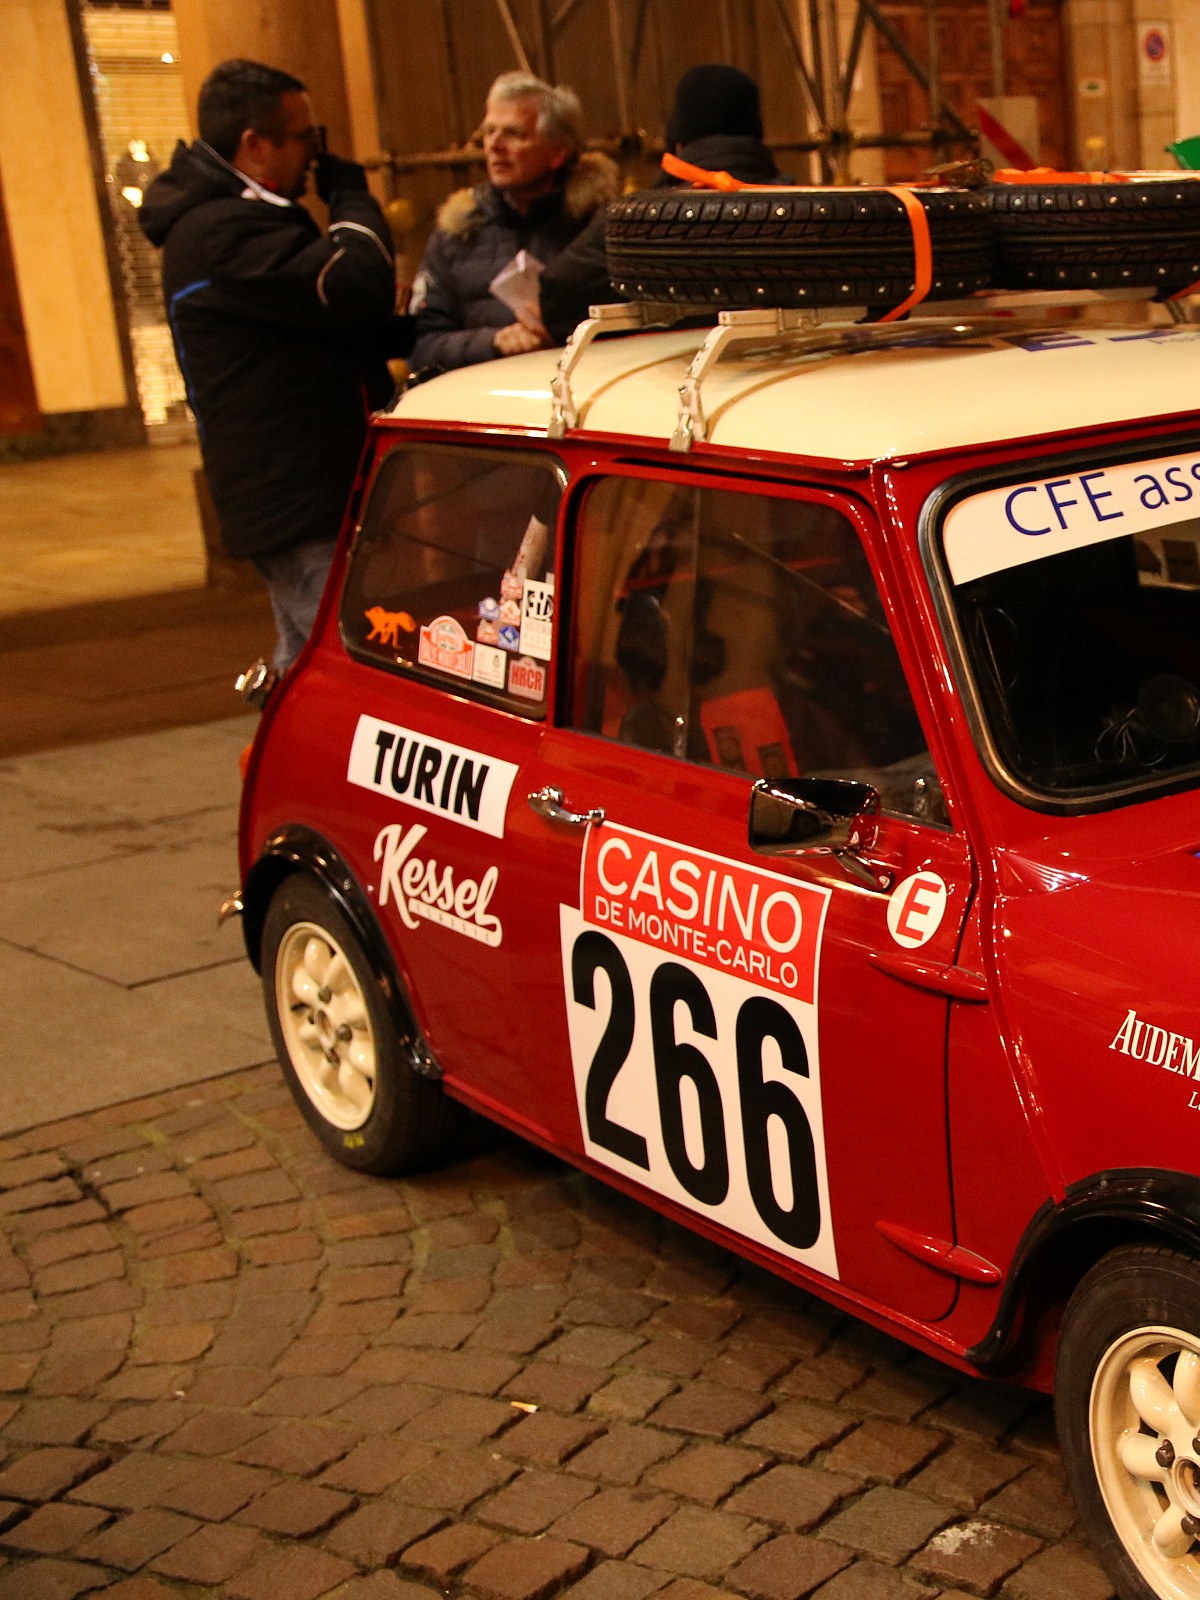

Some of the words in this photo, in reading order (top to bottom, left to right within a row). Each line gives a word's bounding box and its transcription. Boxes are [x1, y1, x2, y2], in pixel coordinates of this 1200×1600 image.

[1004, 473, 1125, 537] CFE
[373, 730, 490, 822] TURIN
[374, 823, 503, 947] Kessel
[597, 837, 802, 953] CASINO
[895, 878, 941, 941] E
[595, 896, 624, 927] DE
[628, 908, 798, 988] MONTE-CARLO
[571, 930, 821, 1250] 266
